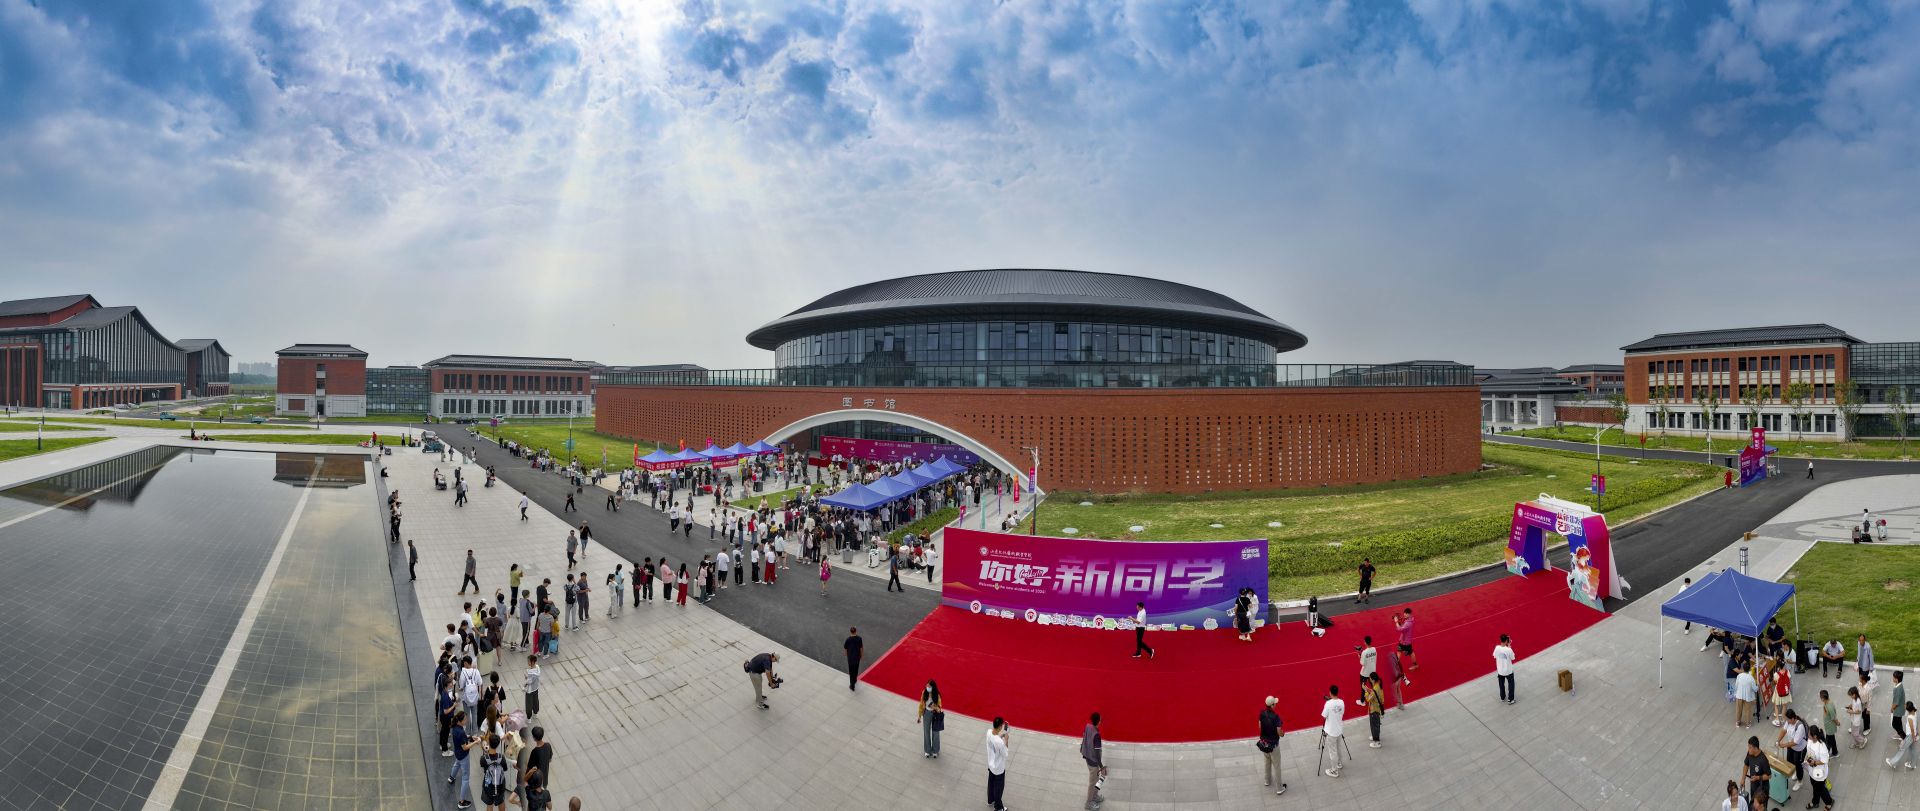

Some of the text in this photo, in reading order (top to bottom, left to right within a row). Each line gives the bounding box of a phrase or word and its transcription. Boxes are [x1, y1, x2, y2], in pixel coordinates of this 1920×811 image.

[979, 558, 1226, 599] 你好 新同学
